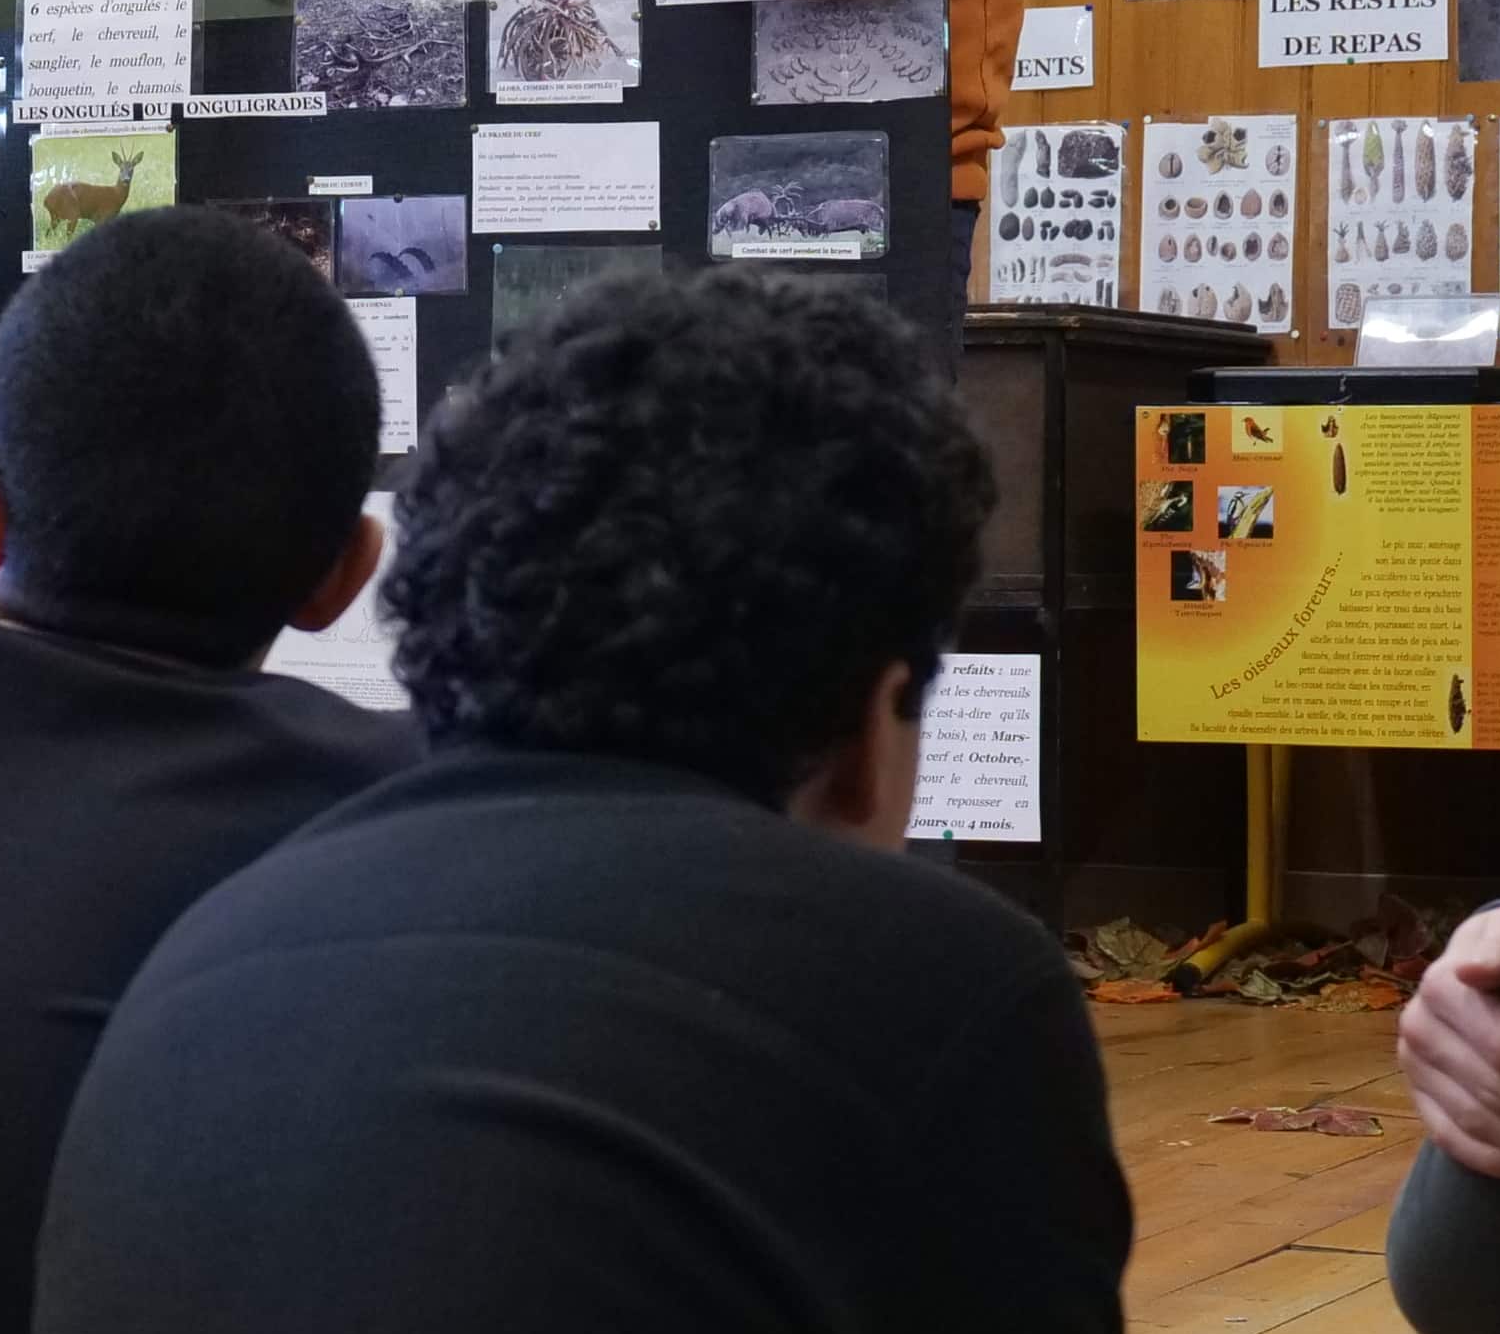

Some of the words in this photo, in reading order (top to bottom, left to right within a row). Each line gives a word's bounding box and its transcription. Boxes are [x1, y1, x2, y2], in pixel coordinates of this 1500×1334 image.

[30, 4, 39, 16] 6
[47, 2, 93, 18] espèces
[100, 0, 160, 16] d'ongulés
[29, 29, 55, 44] cerf,
[72, 29, 83, 42] le
[98, 26, 159, 41] chevreuil,
[175, 25, 187, 39] le
[1284, 36, 1321, 56] DE
[1329, 32, 1422, 54] REPAS
[28, 56, 81, 72] sanglier,
[90, 55, 102, 68] le
[110, 53, 165, 69] mouflon,
[175, 53, 187, 65] le
[28, 83, 95, 98] bouquetin,
[107, 82, 119, 95] le
[129, 81, 184, 94] chamois.
[18, 105, 49, 120] LES
[52, 101, 130, 119] ONGULÉS
[144, 102, 168, 116] OU
[187, 96, 323, 115] ONGULIGRADES
[952, 664, 995, 676] refaits
[1010, 668, 1032, 676] une
[1209, 676, 1241, 701] Les
[1243, 626, 1299, 683] oiseaux
[950, 820, 965, 828] ou
[979, 818, 1015, 830] mois.
